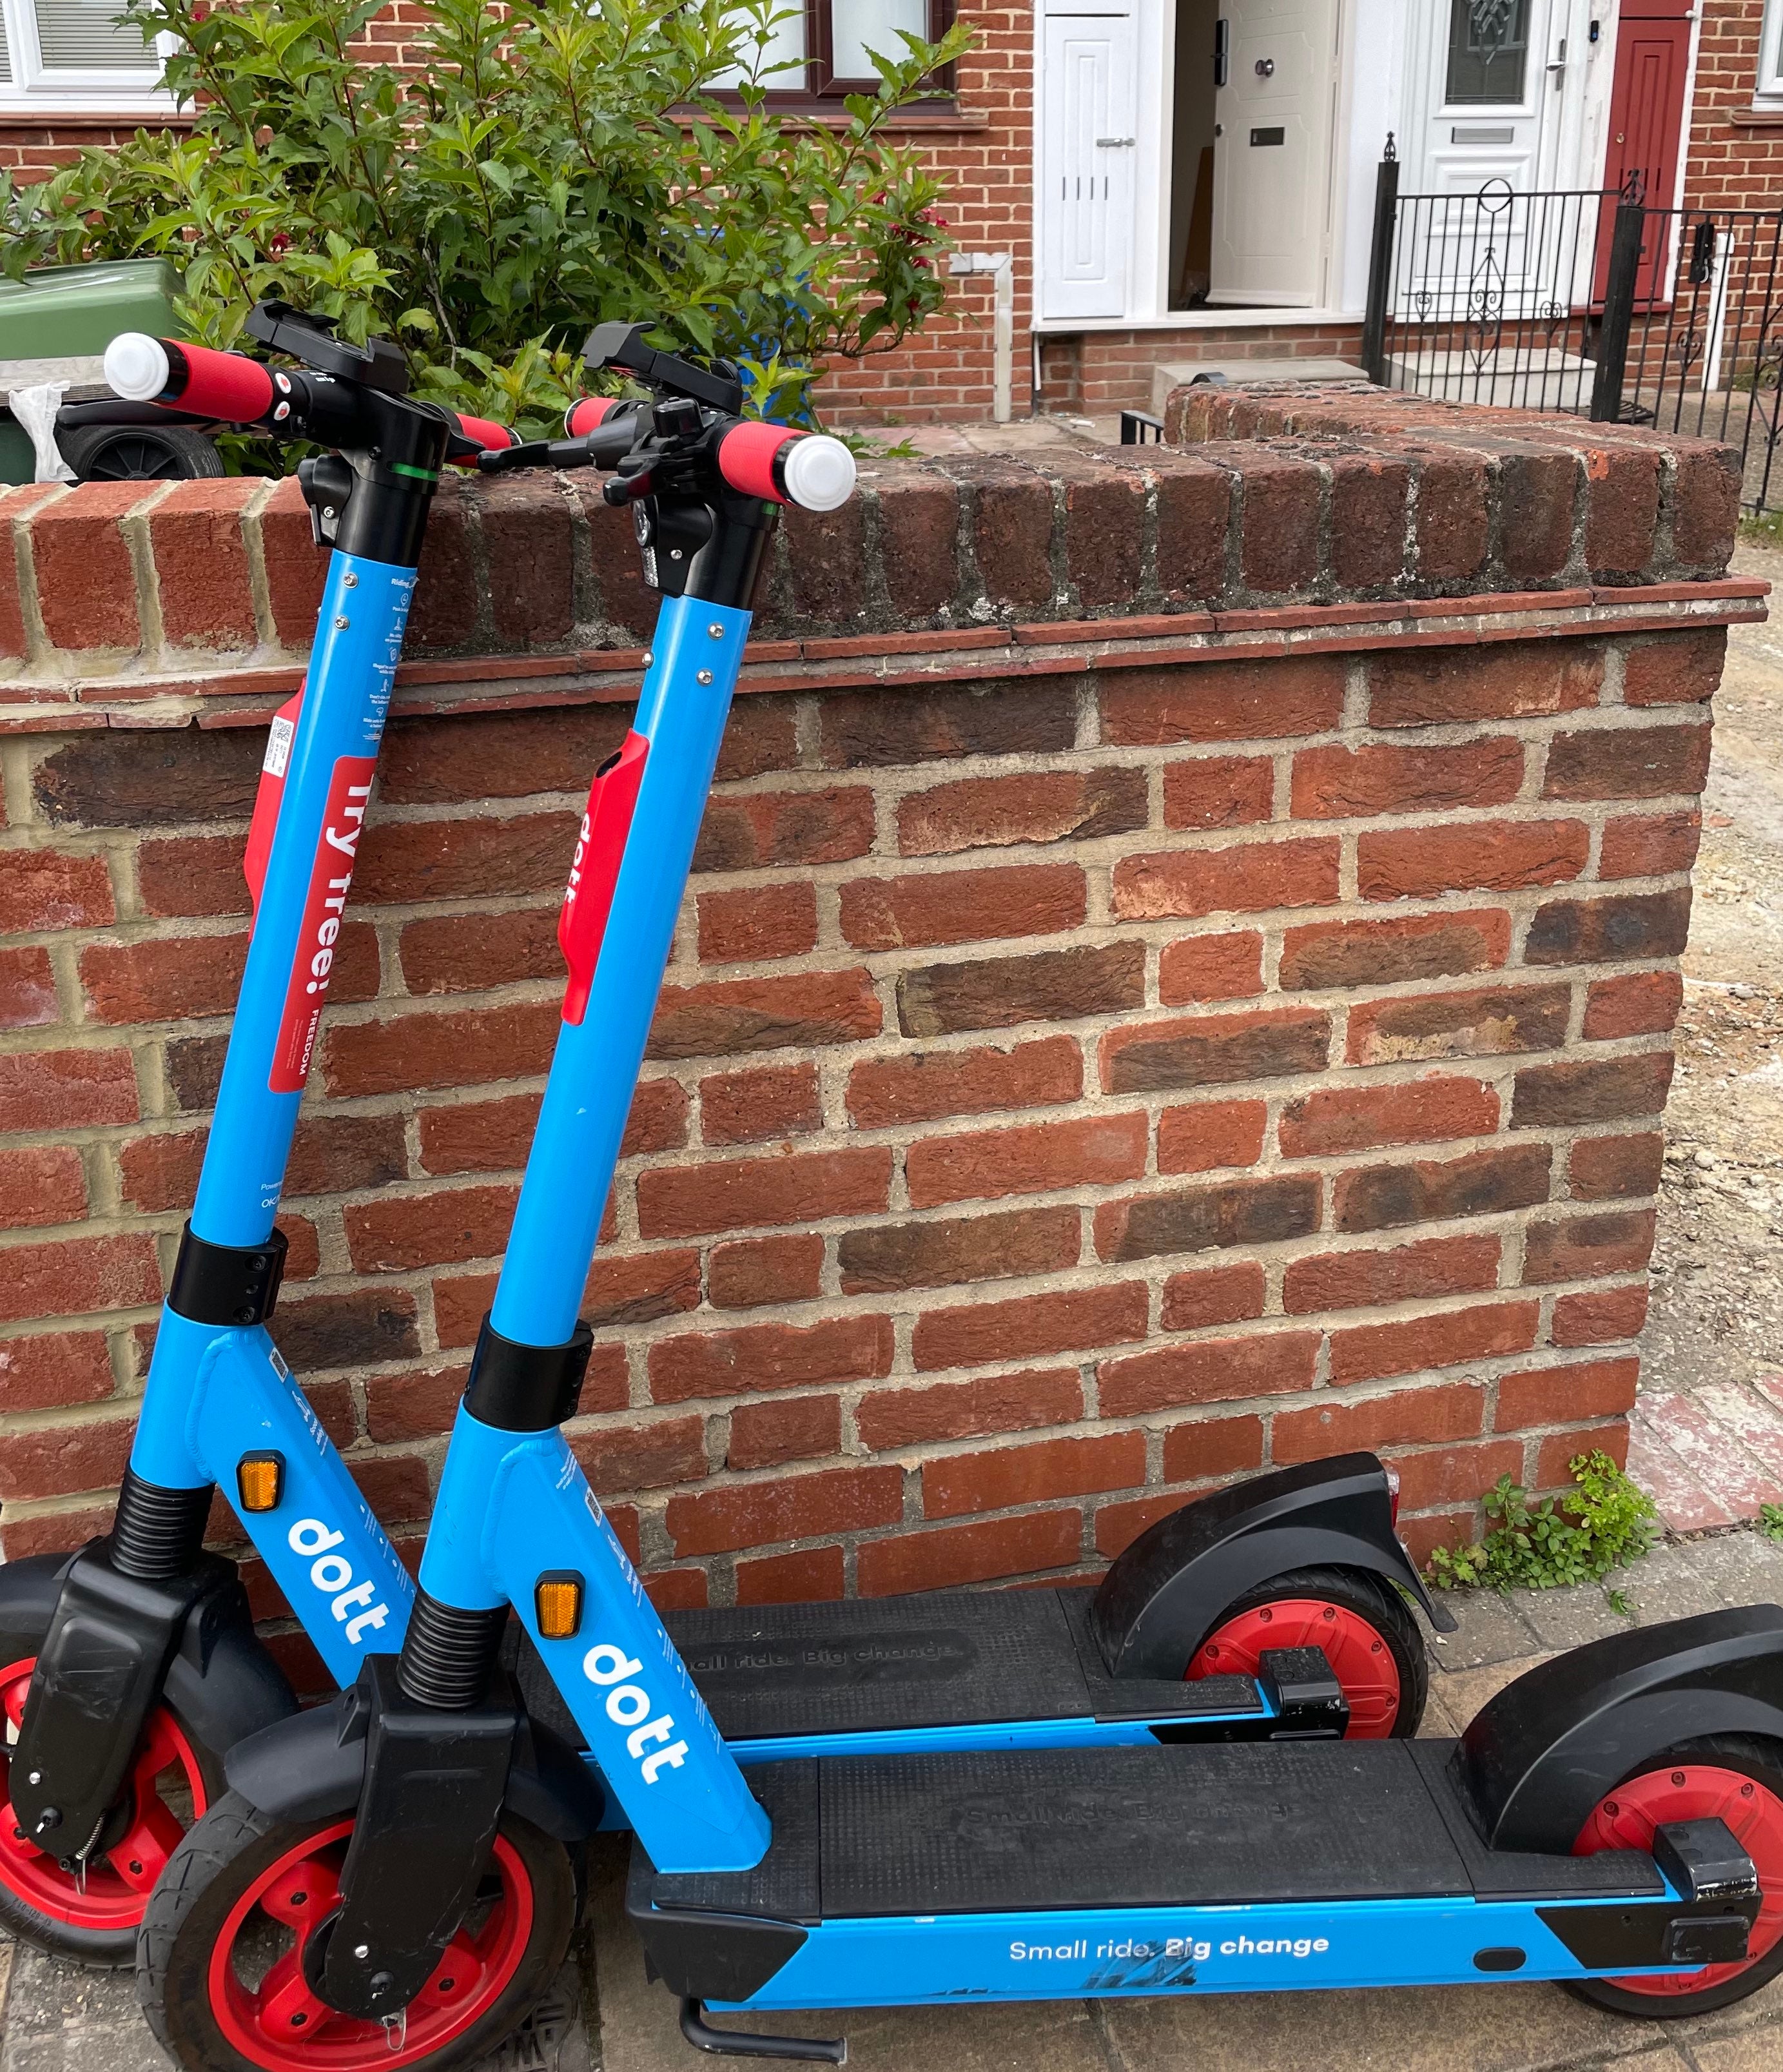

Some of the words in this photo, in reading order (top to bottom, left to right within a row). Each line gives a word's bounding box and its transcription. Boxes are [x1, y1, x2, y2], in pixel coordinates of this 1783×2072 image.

[298, 1009, 320, 1076] FREEDOM
[288, 1518, 389, 1645] dott
[803, 1648, 846, 1666] Big
[583, 1644, 689, 1784] dott
[1009, 1939, 1087, 1960] Small
[1096, 1939, 1155, 1958] ride.
[1165, 1936, 1212, 1960] Big
[1220, 1935, 1330, 1958] change
